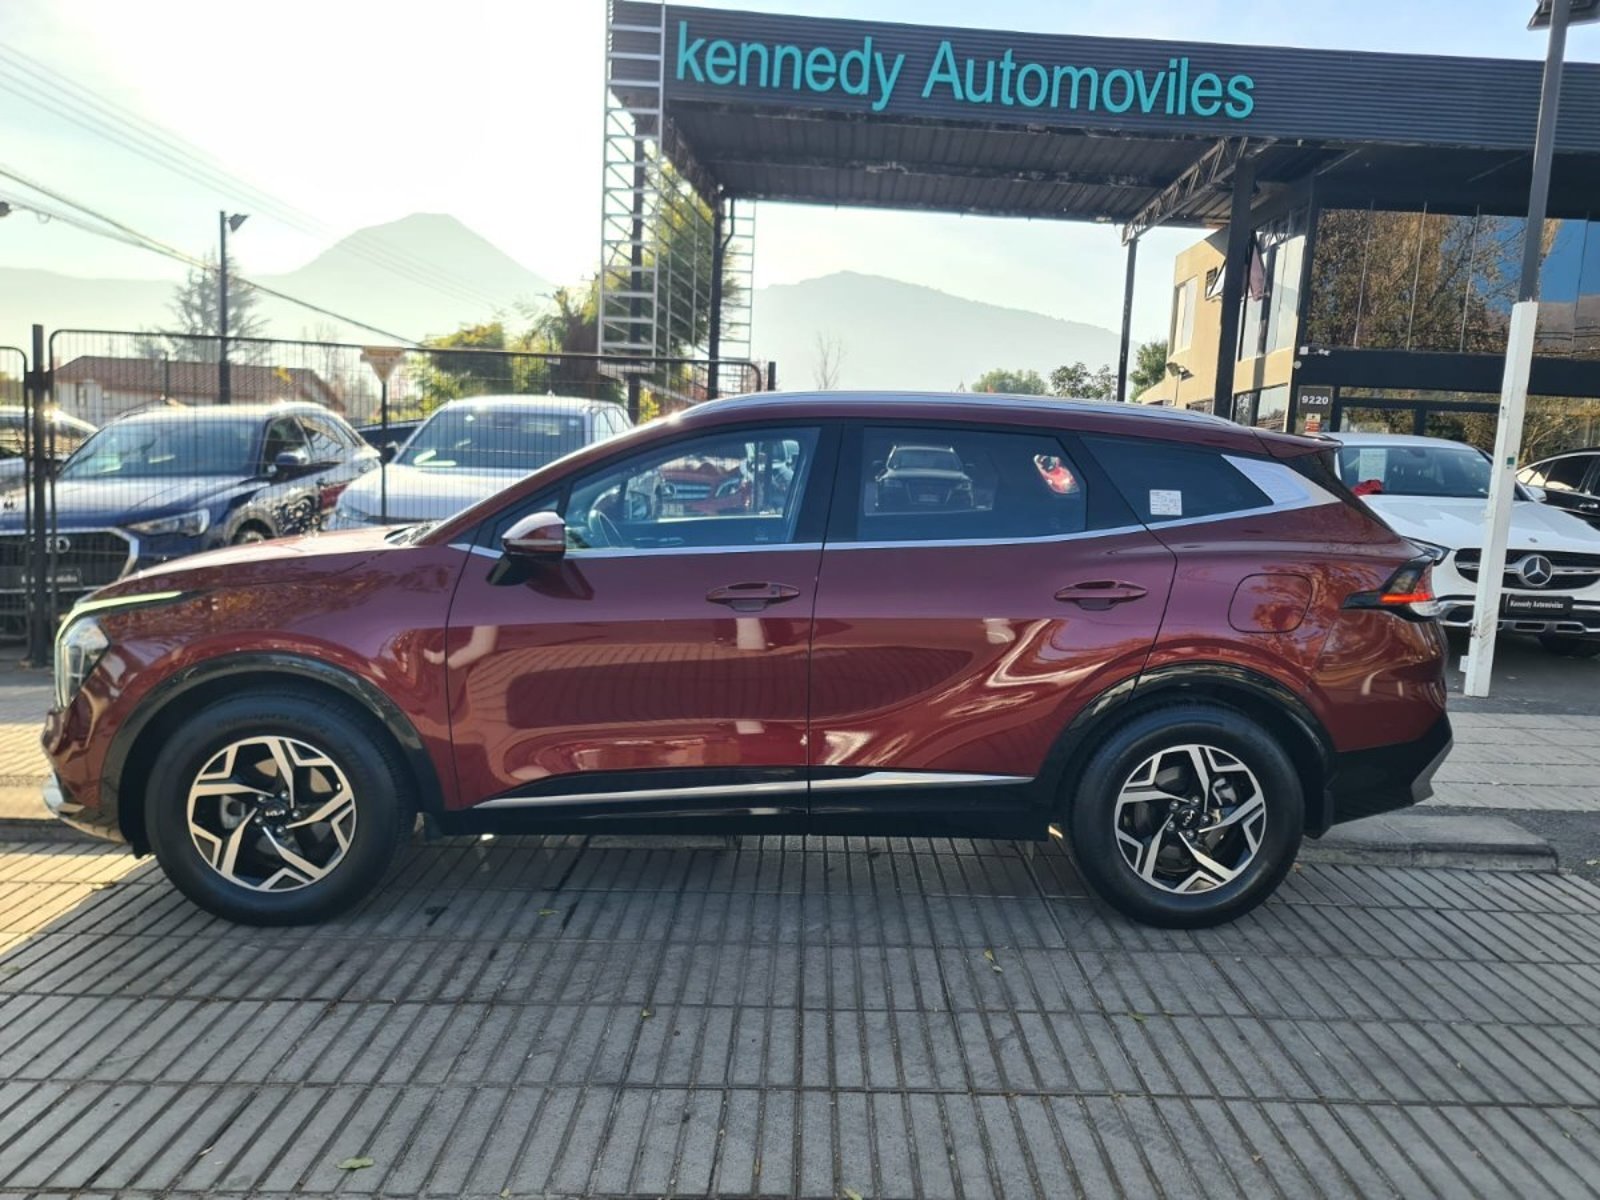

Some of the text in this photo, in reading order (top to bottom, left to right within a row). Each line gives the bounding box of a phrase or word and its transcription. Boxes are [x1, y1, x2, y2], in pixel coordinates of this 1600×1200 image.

[676, 20, 1255, 119] kennedy Automoviles
[1302, 395, 1329, 405] 9220
